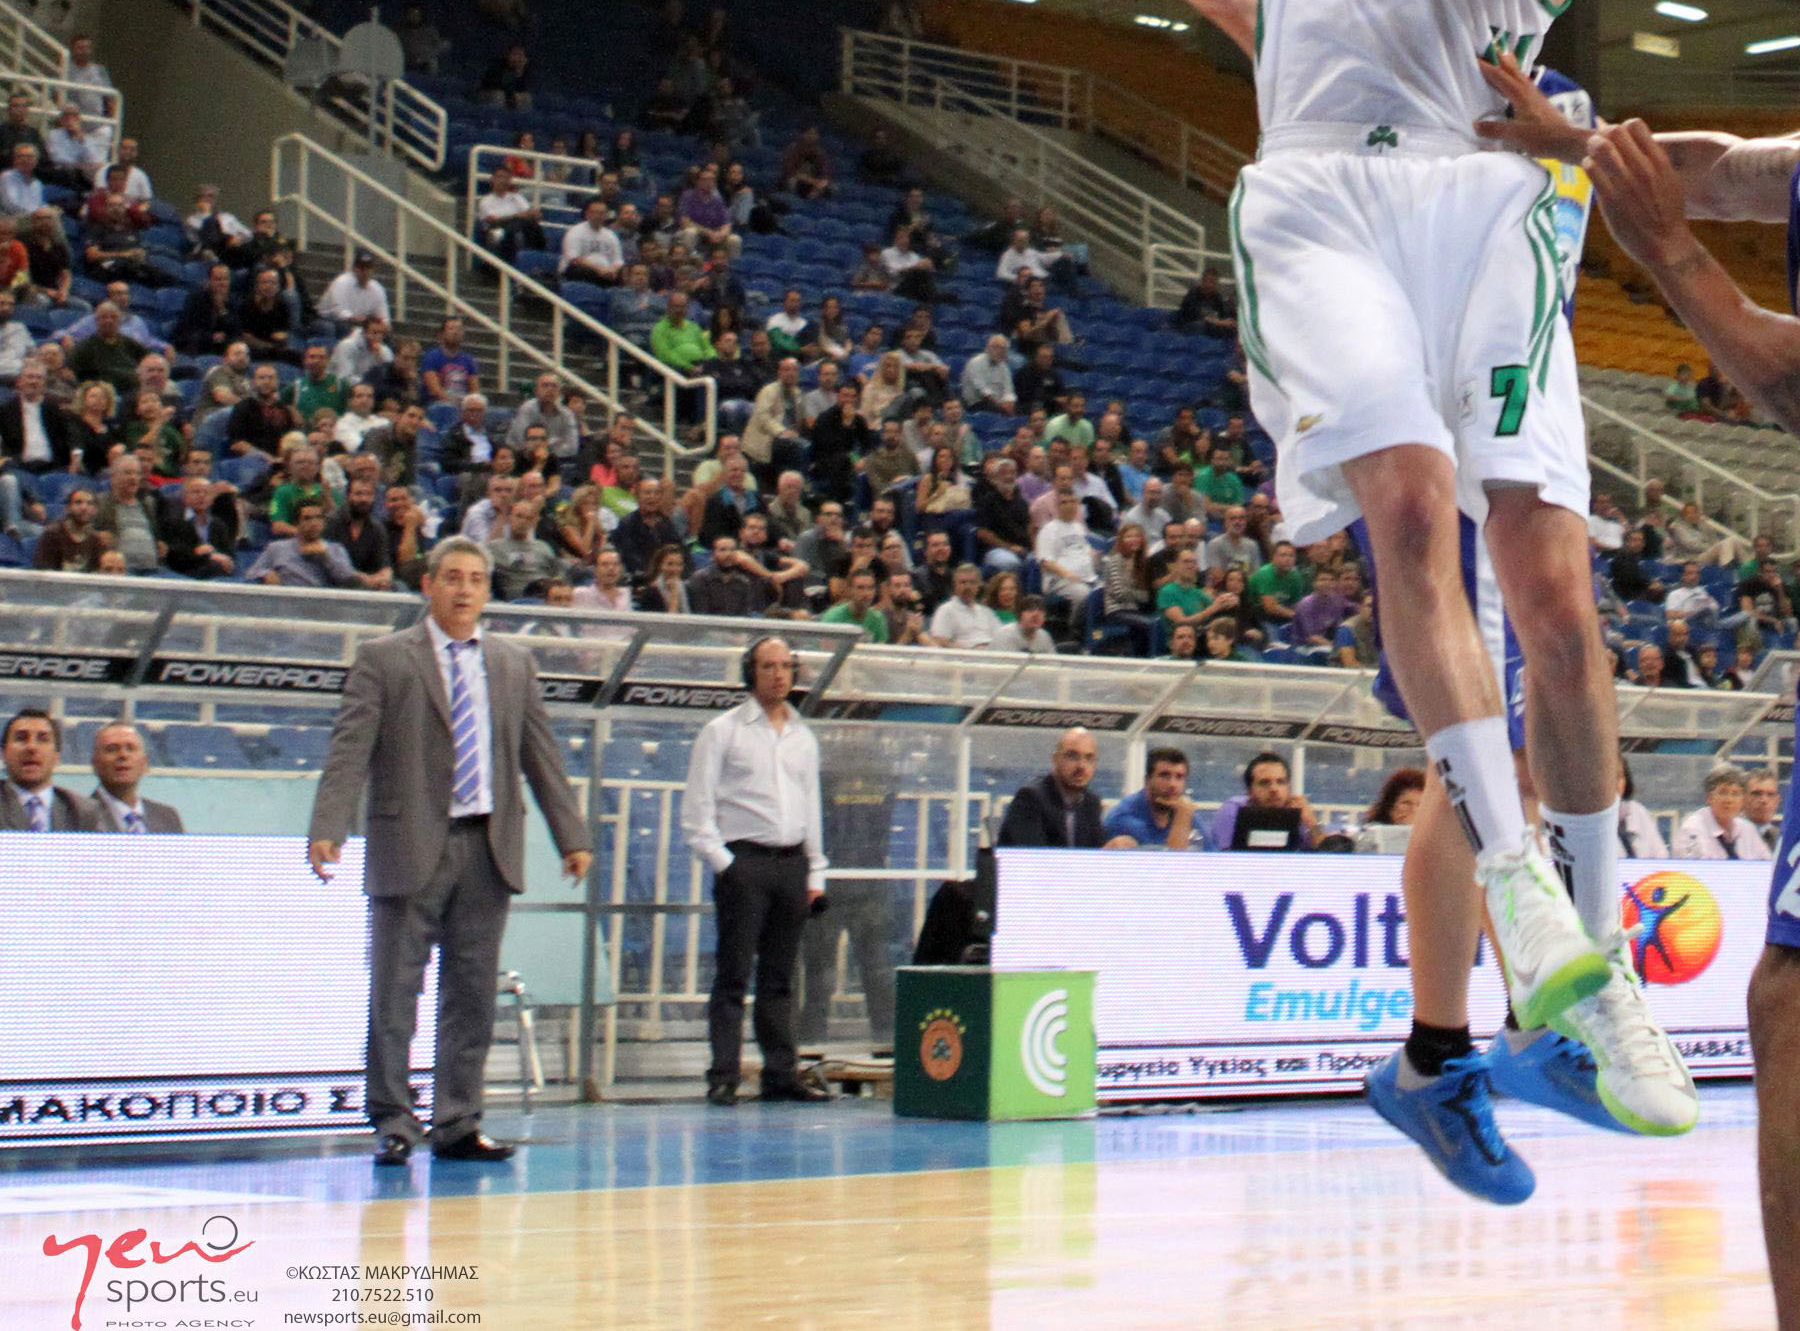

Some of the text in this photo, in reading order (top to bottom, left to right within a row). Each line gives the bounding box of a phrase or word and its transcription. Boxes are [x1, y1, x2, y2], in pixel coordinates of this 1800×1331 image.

[1490, 364, 1529, 437] 7
[160, 662, 347, 690] POWERADE
[624, 687, 752, 709] POWERA
[1223, 891, 1410, 969] Volt
[1244, 978, 1414, 1031] Emulge
